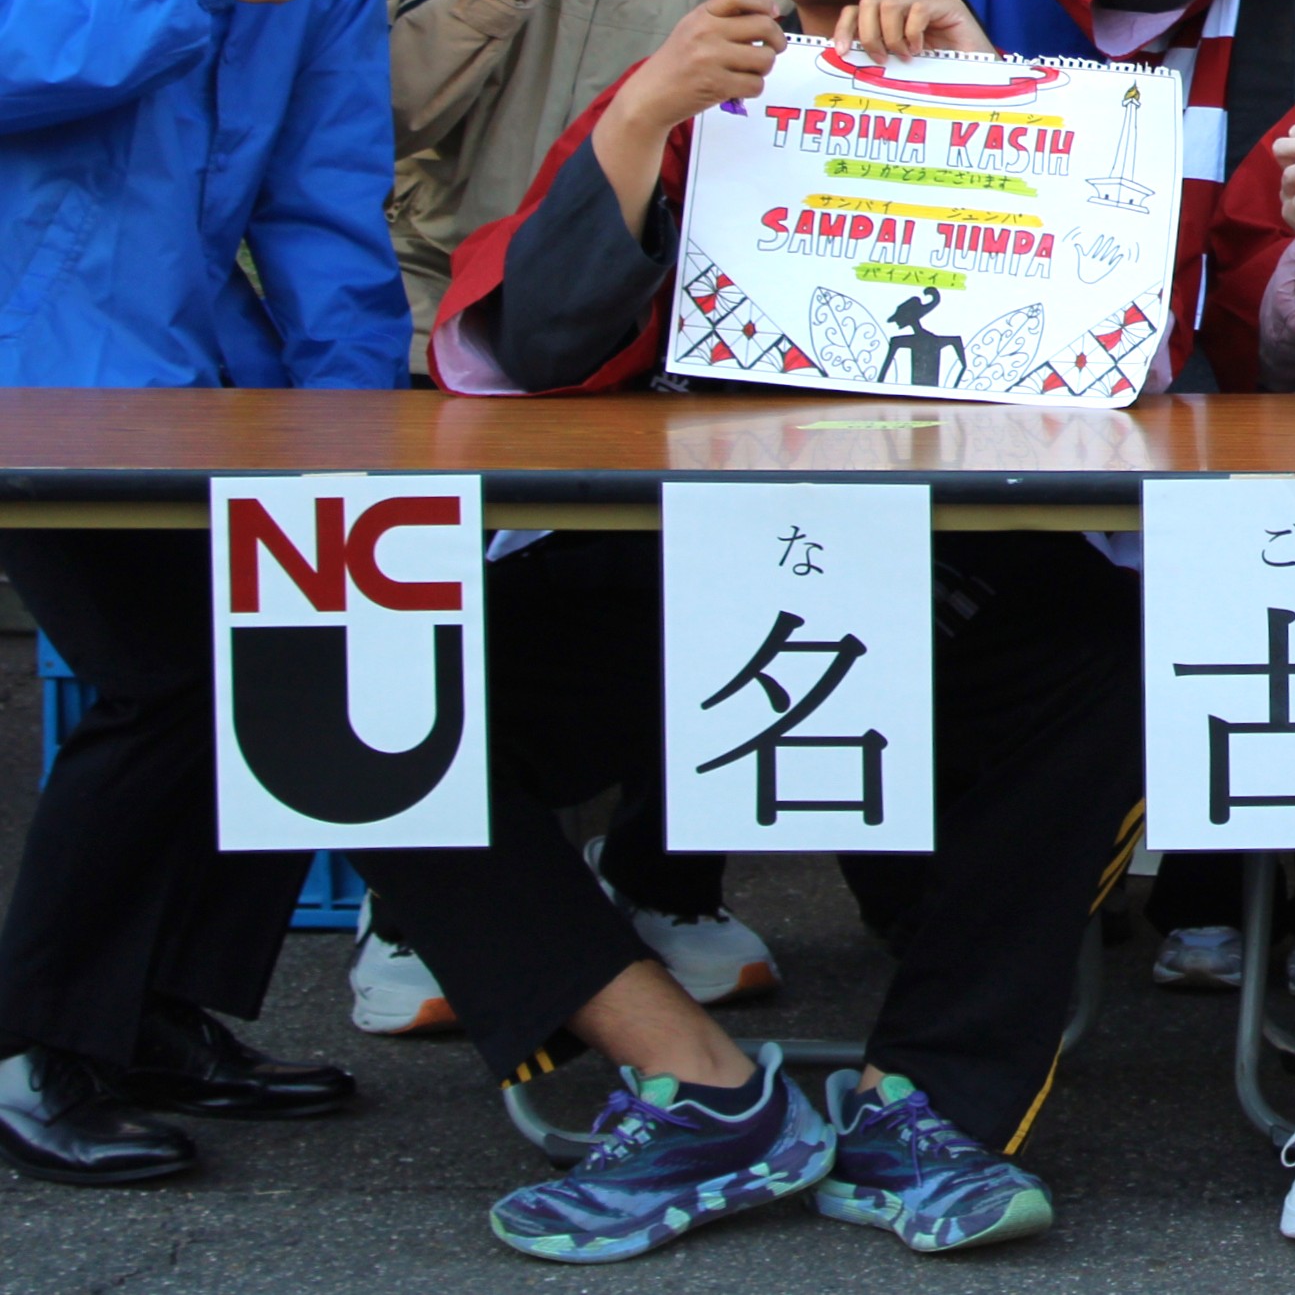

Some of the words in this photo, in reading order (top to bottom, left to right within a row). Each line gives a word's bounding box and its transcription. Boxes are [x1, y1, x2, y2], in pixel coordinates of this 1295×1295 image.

[765, 106, 928, 163] TERIMA
[946, 121, 1076, 176] KASIH
[834, 159, 1012, 190] ありがとうございます
[757, 206, 916, 264] SAMPAI
[930, 222, 1055, 279] JUMPA
[777, 525, 825, 578] な
[695, 609, 889, 826] 名
